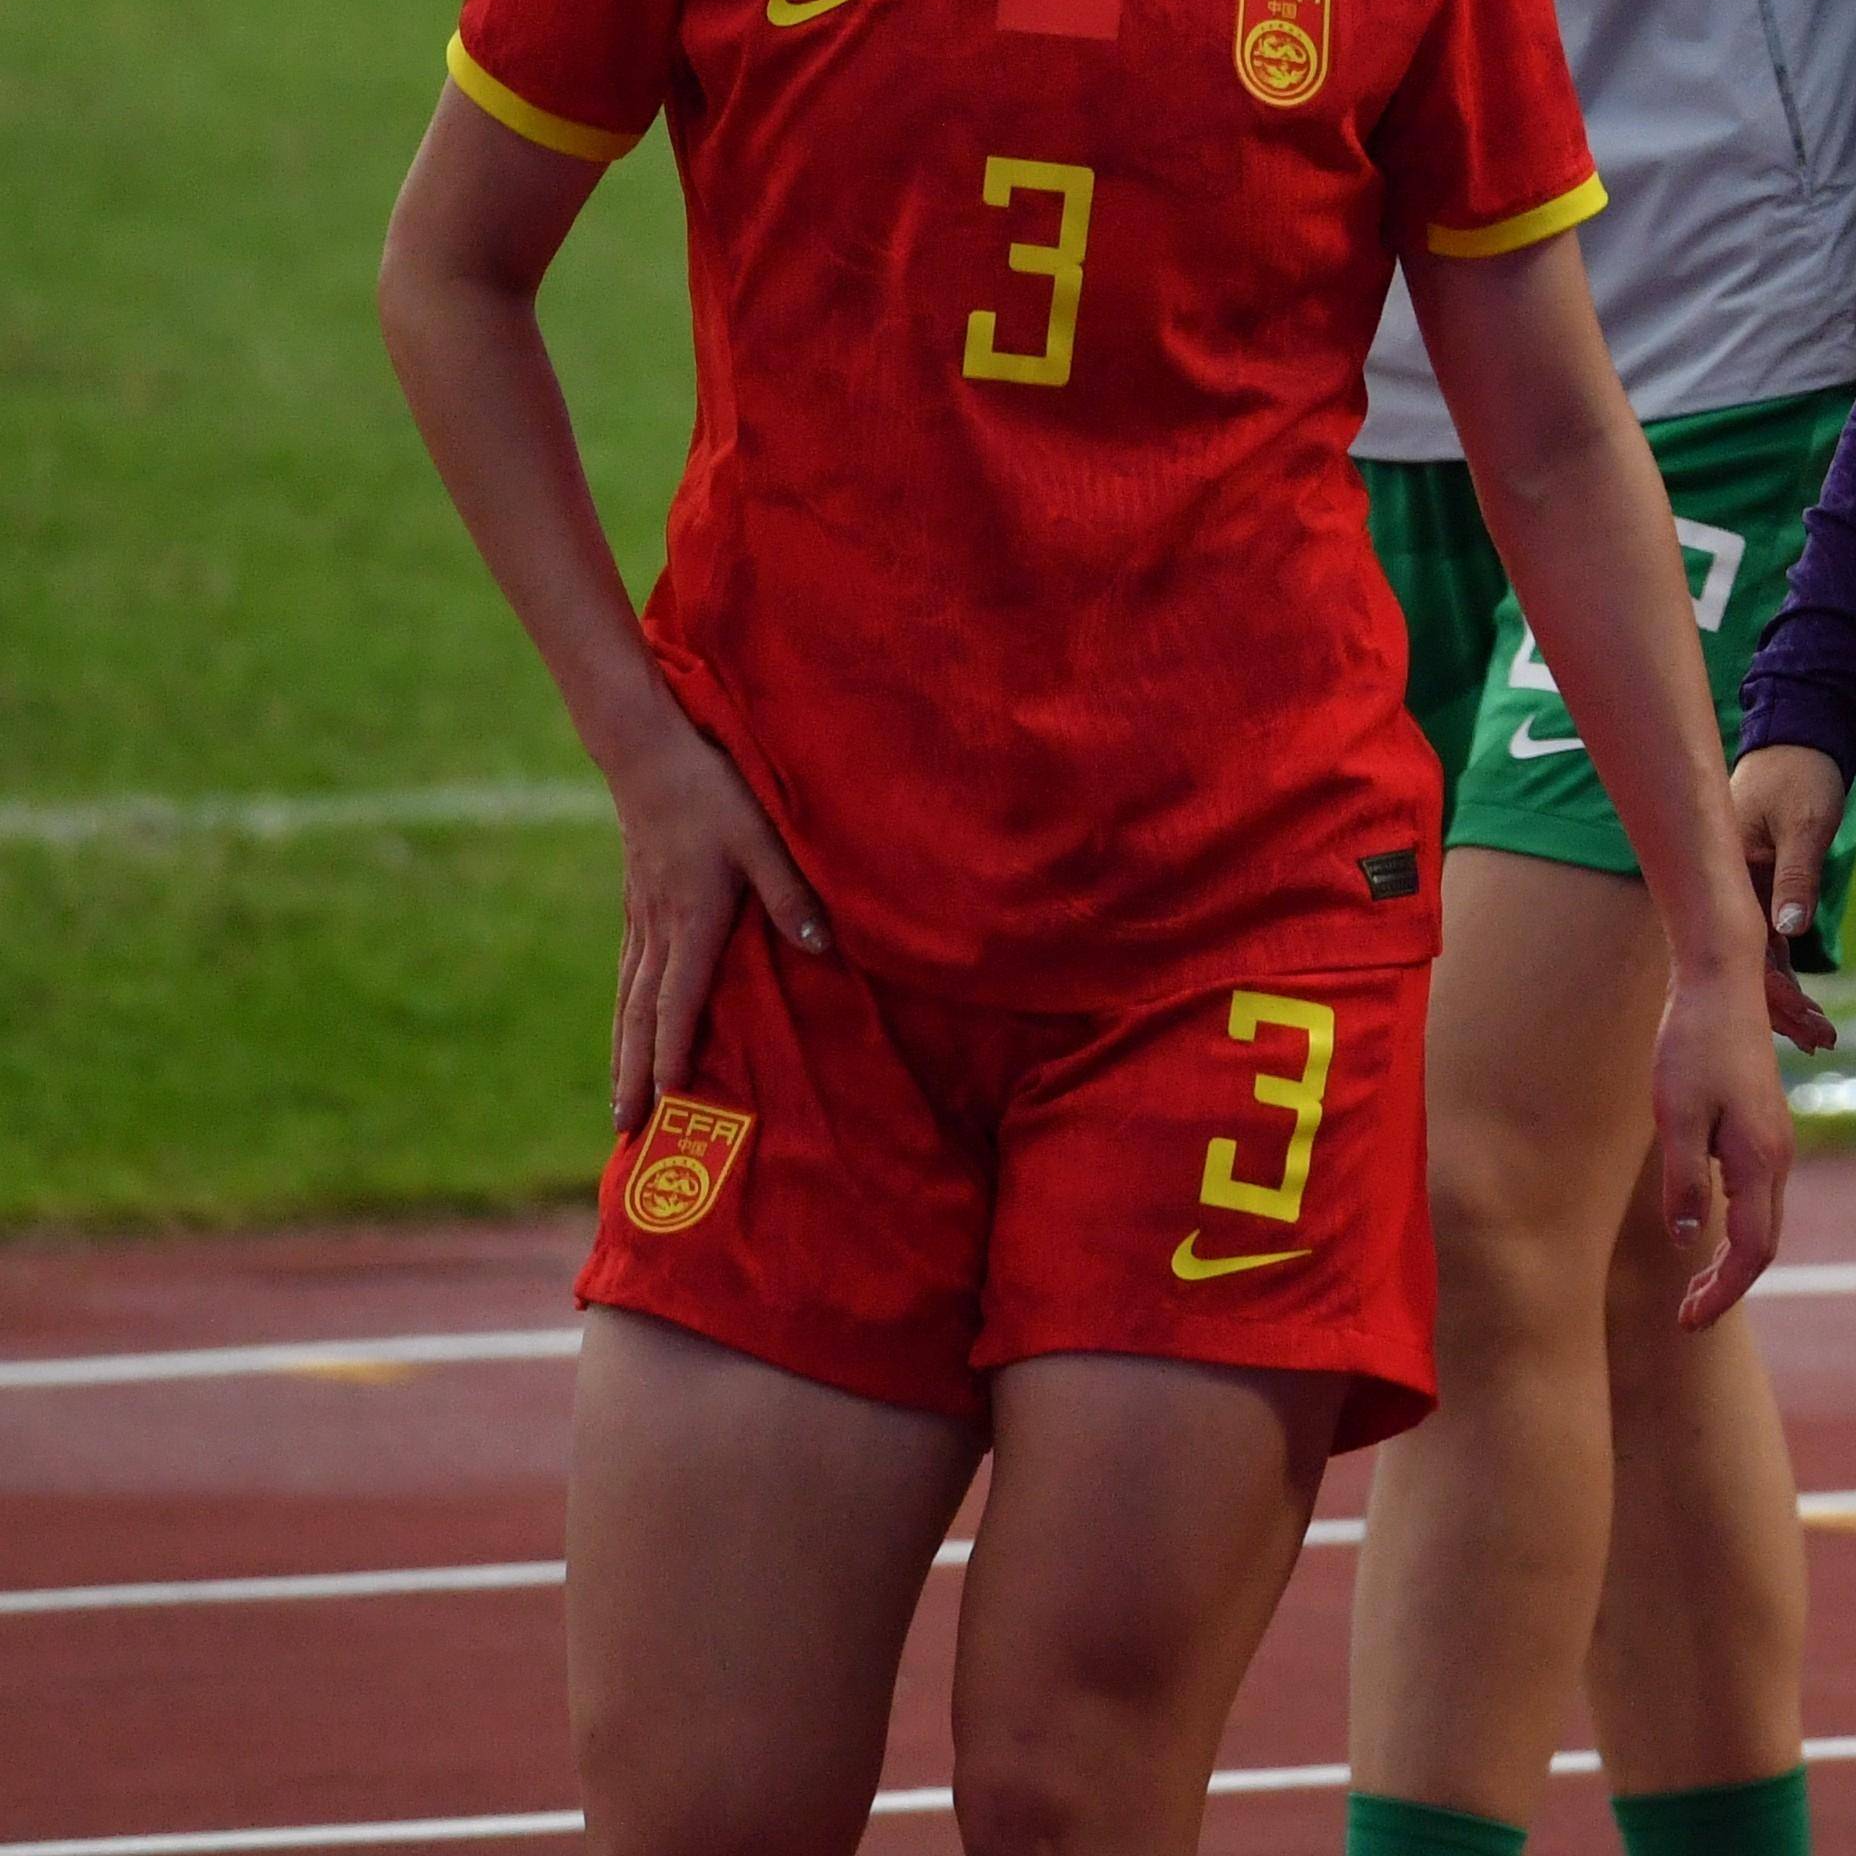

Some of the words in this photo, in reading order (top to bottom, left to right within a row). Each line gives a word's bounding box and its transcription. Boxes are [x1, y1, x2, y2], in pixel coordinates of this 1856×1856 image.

[962, 154, 1095, 386] 3
[661, 1107, 739, 1146] CFA
[1200, 989, 1335, 1223] 3
